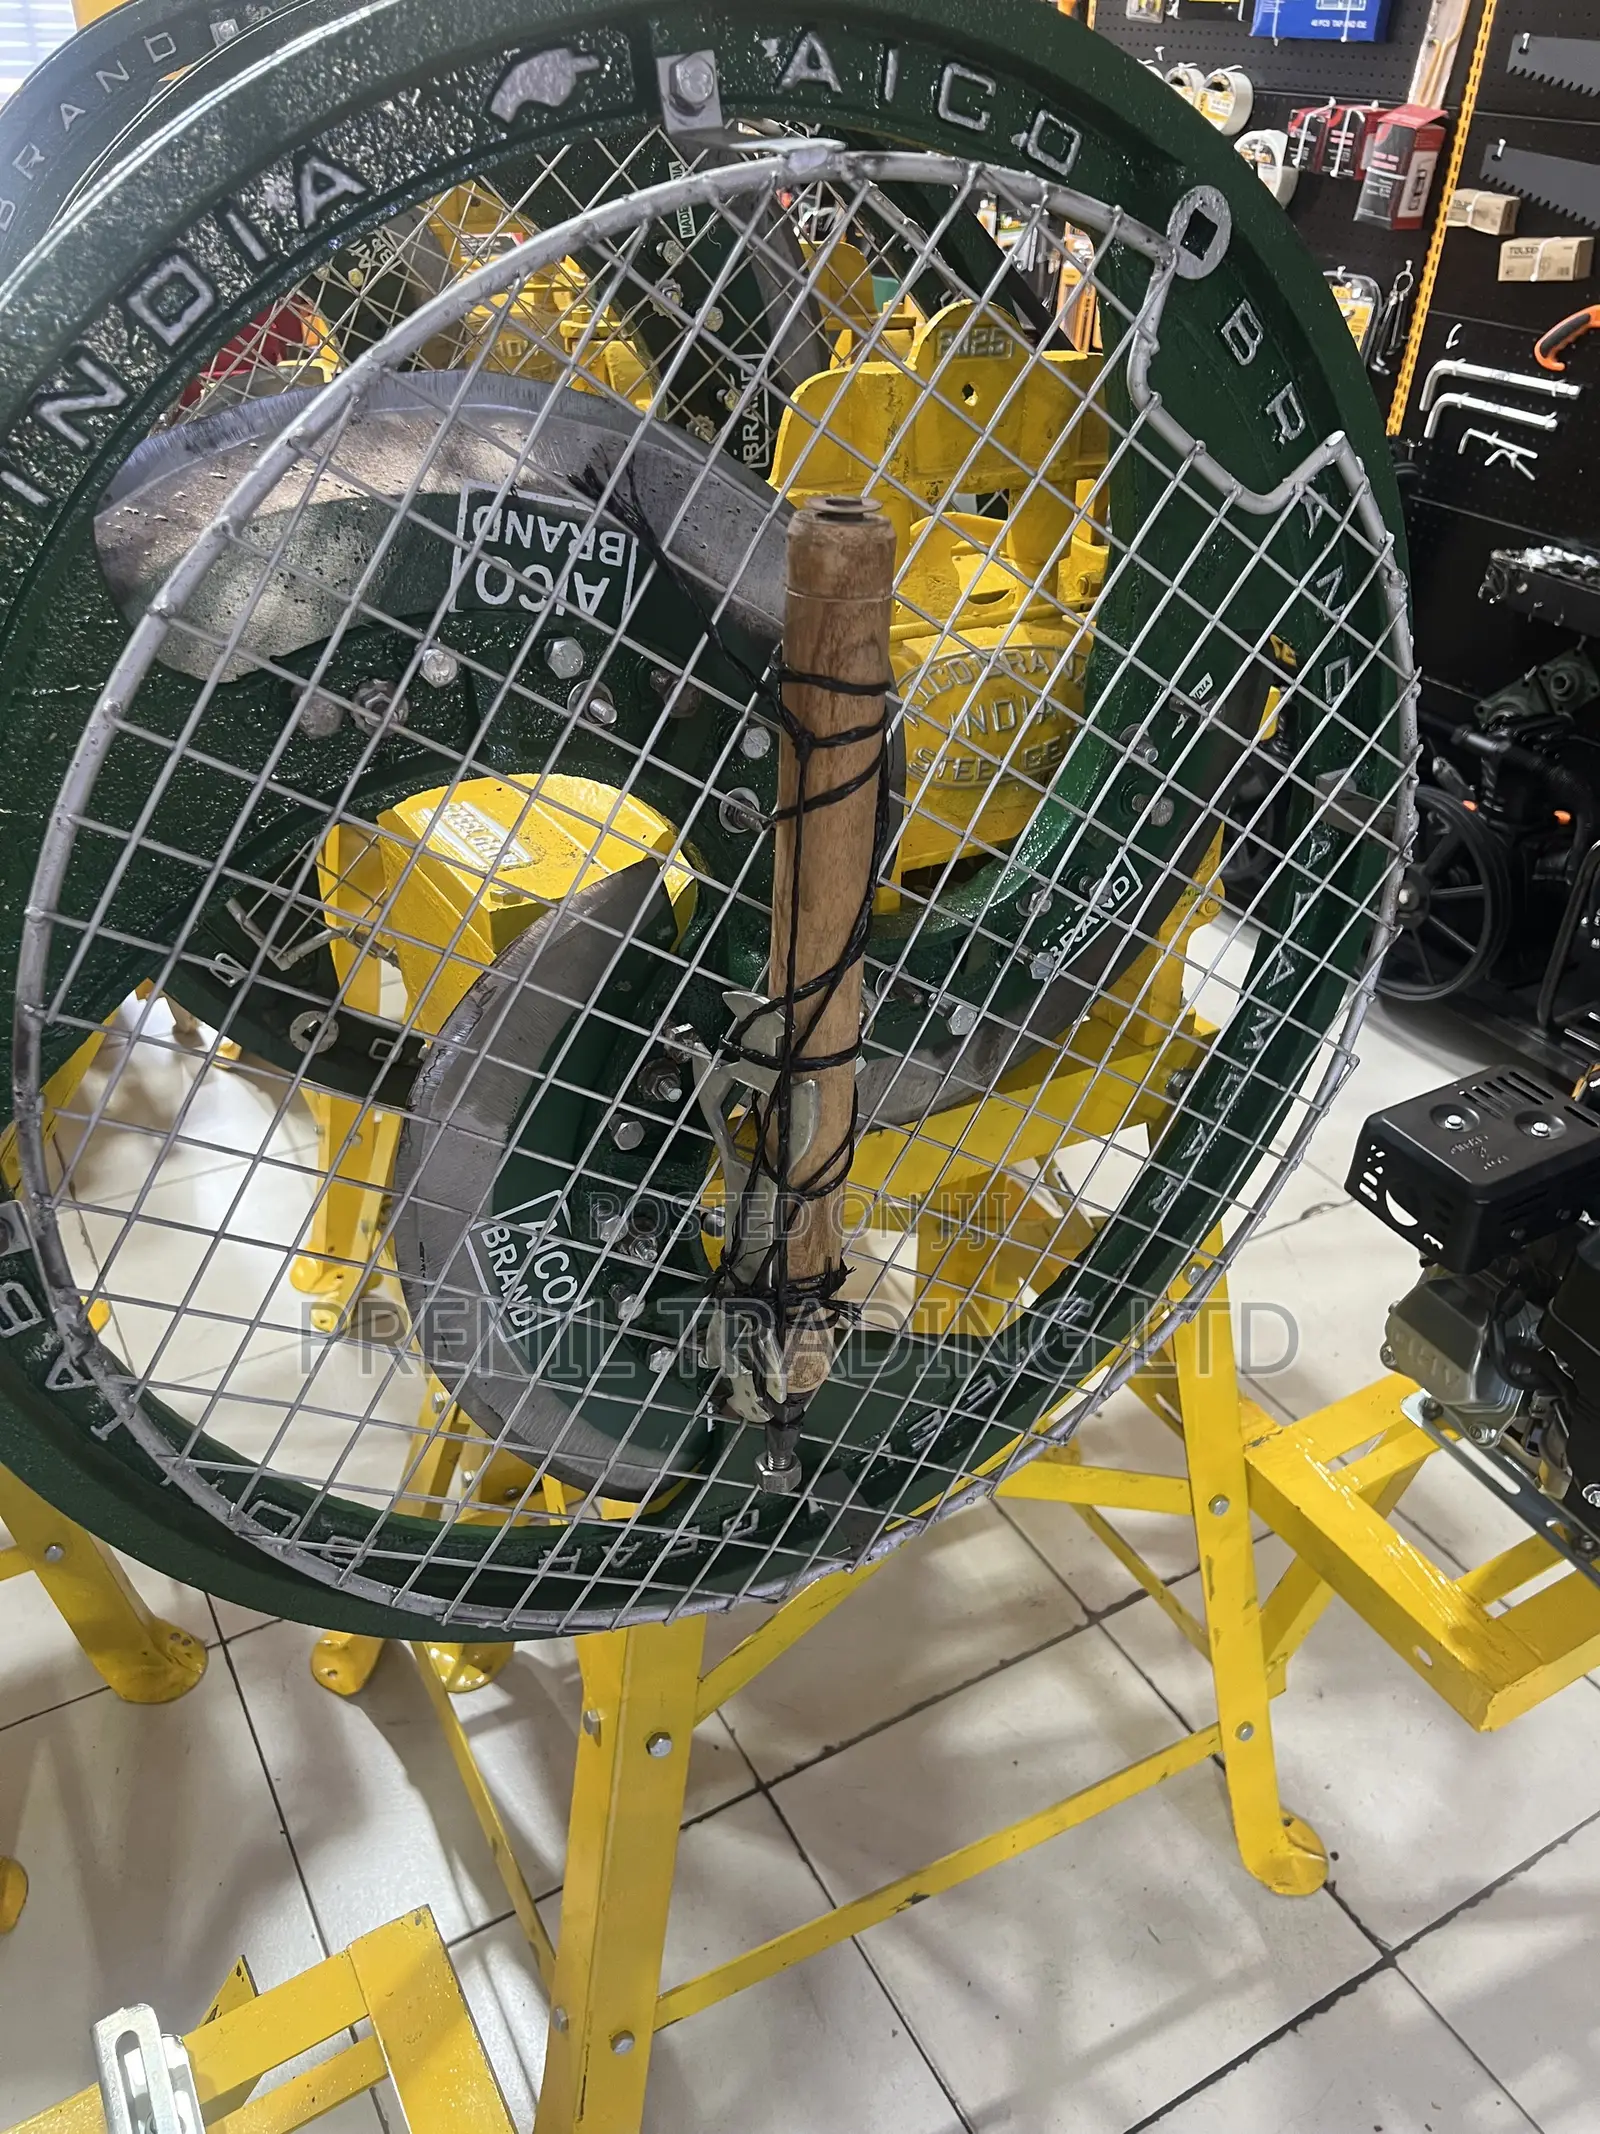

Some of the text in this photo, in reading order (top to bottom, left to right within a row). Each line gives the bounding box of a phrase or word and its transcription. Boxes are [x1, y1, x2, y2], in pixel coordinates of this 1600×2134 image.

[0, 155, 366, 508] INDIA
[777, 30, 1084, 177] AICO
[472, 505, 626, 567] BRAND
[475, 555, 611, 618] AICO
[951, 695, 1056, 737] INDIA
[481, 1225, 538, 1328] BRAND
[519, 1219, 578, 1305] AICO
